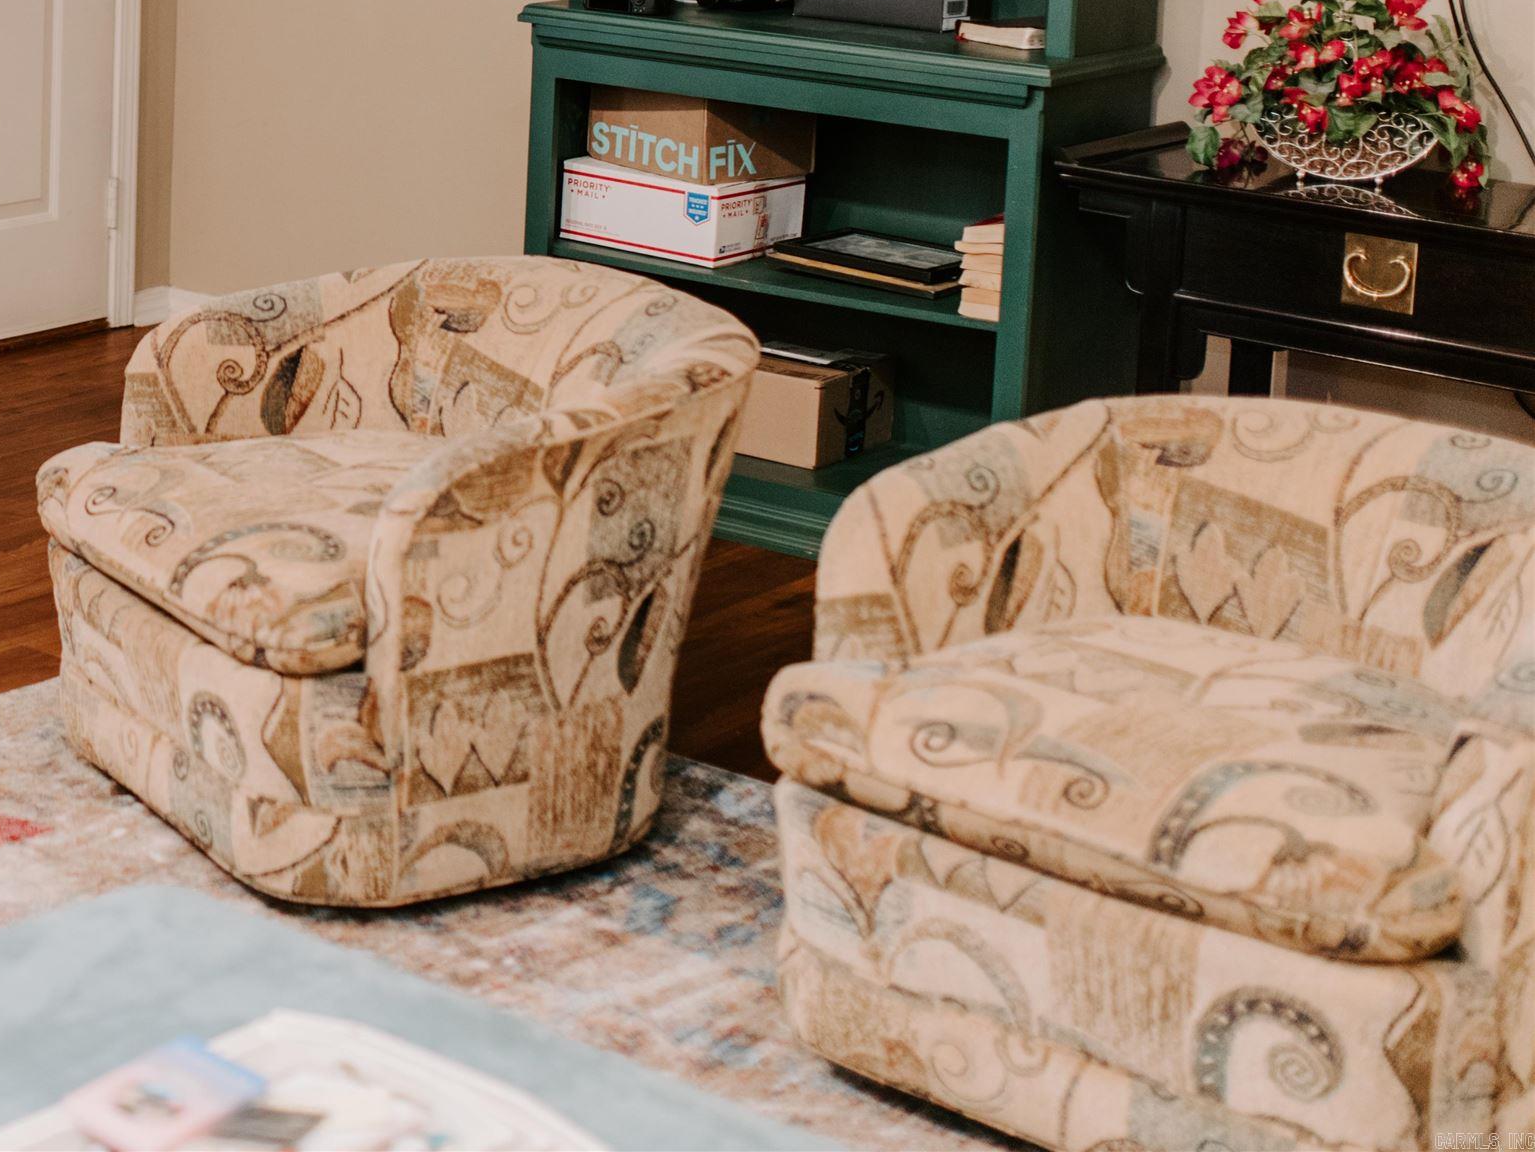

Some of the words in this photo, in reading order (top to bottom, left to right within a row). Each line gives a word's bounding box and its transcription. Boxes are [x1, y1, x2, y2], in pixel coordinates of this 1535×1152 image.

[567, 177, 610, 193] PRIORITY
[576, 189, 599, 199] MAIL
[720, 200, 752, 211] PRIORITY
[727, 210, 745, 218] MAIL
